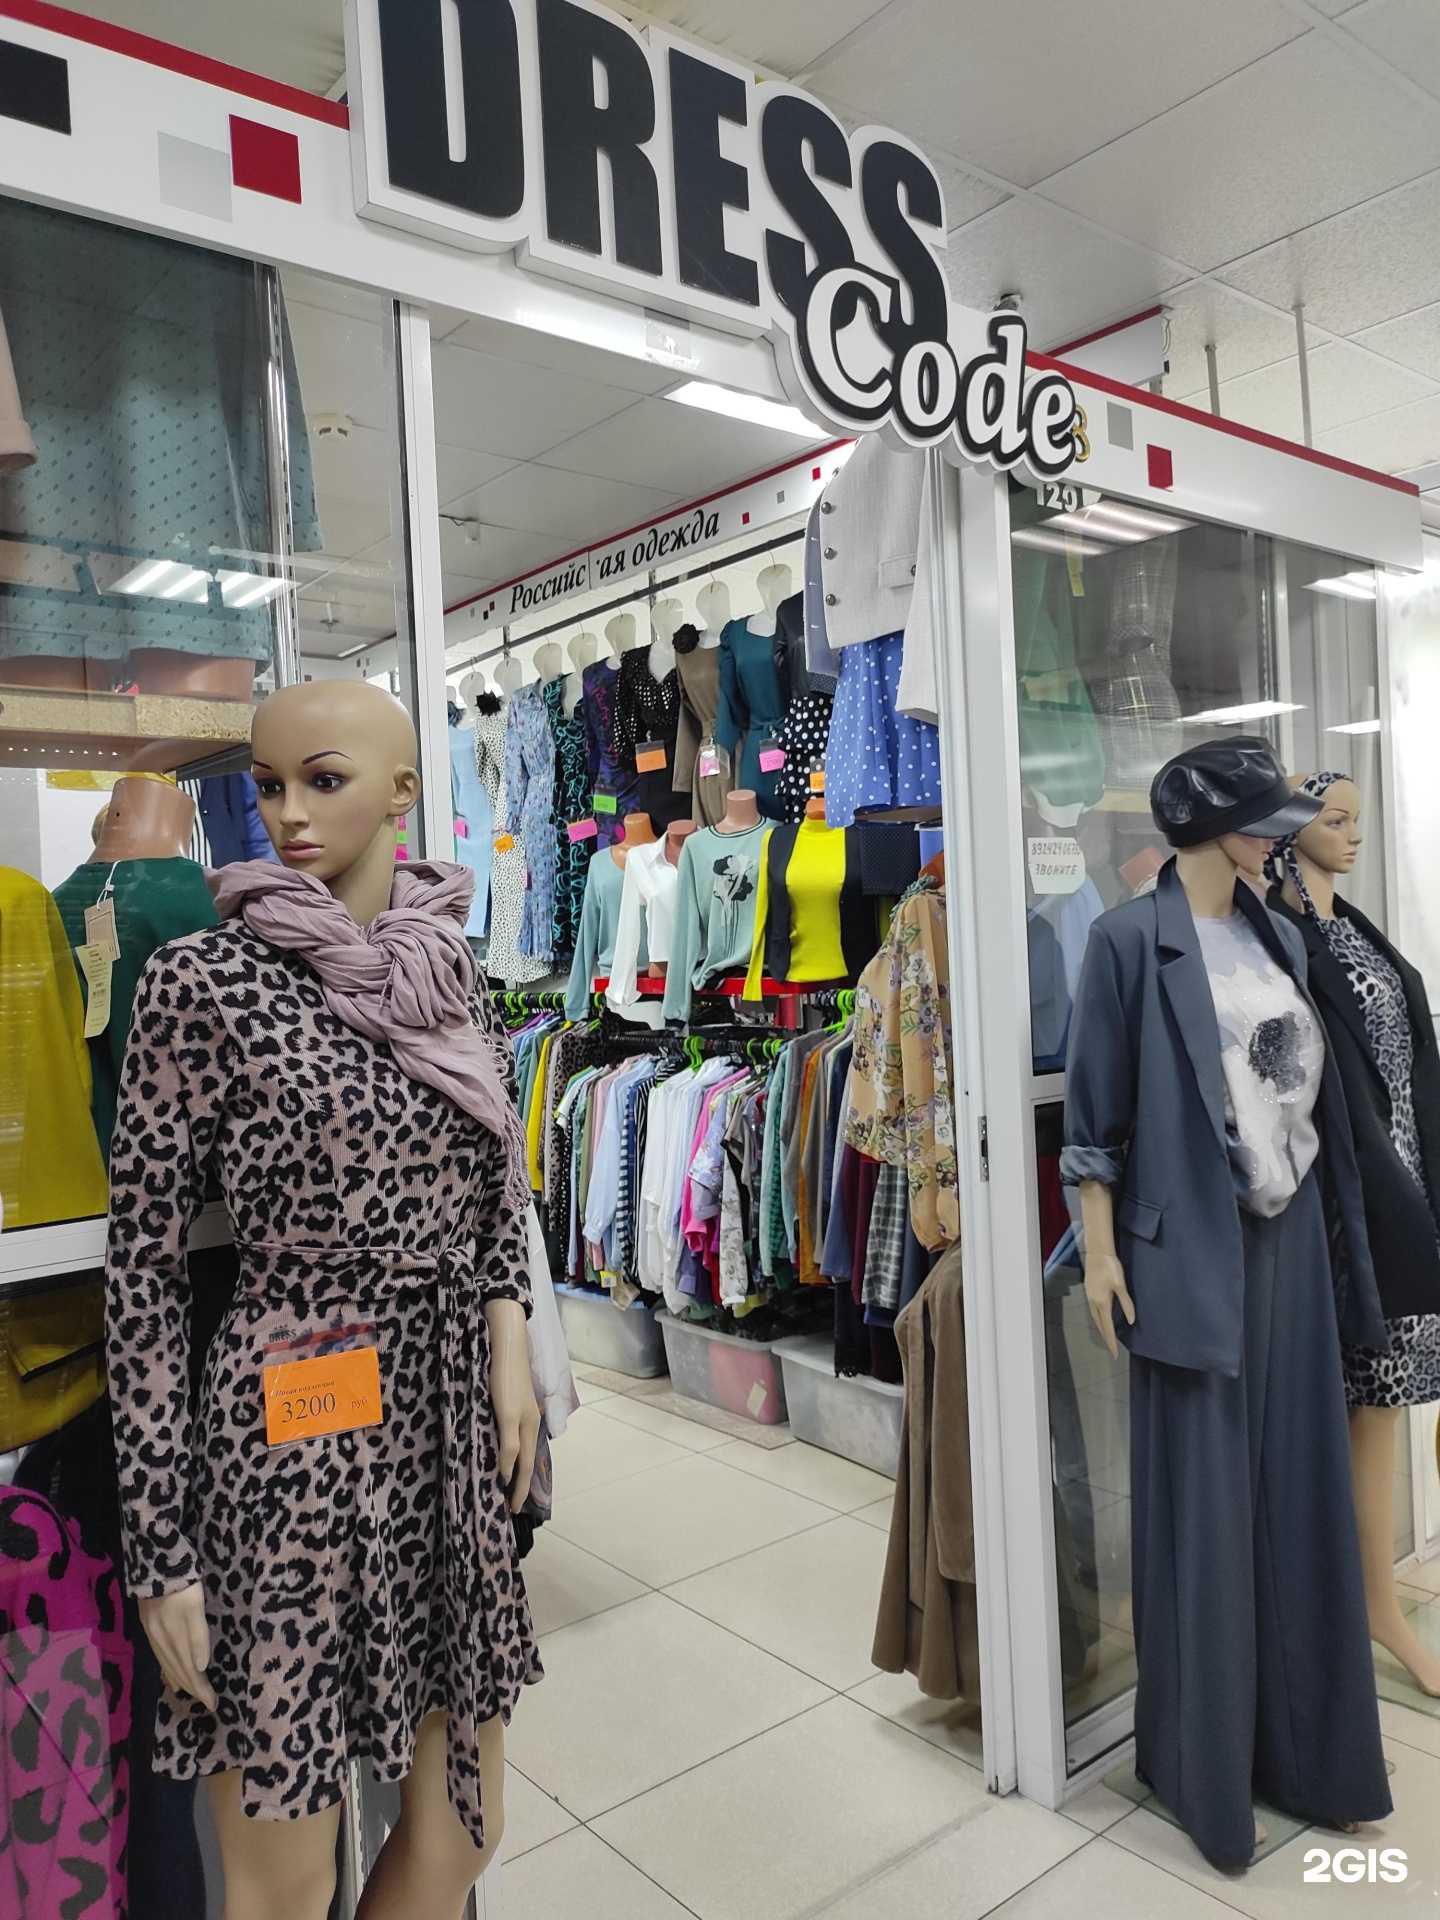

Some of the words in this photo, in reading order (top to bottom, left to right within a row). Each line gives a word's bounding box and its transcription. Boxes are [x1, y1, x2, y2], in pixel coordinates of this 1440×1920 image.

[379, 0, 948, 344] DRESS
[798, 263, 1075, 473] Code
[508, 547, 626, 615] Российсая
[631, 508, 720, 567] одежда
[280, 1392, 336, 1423] 3200
